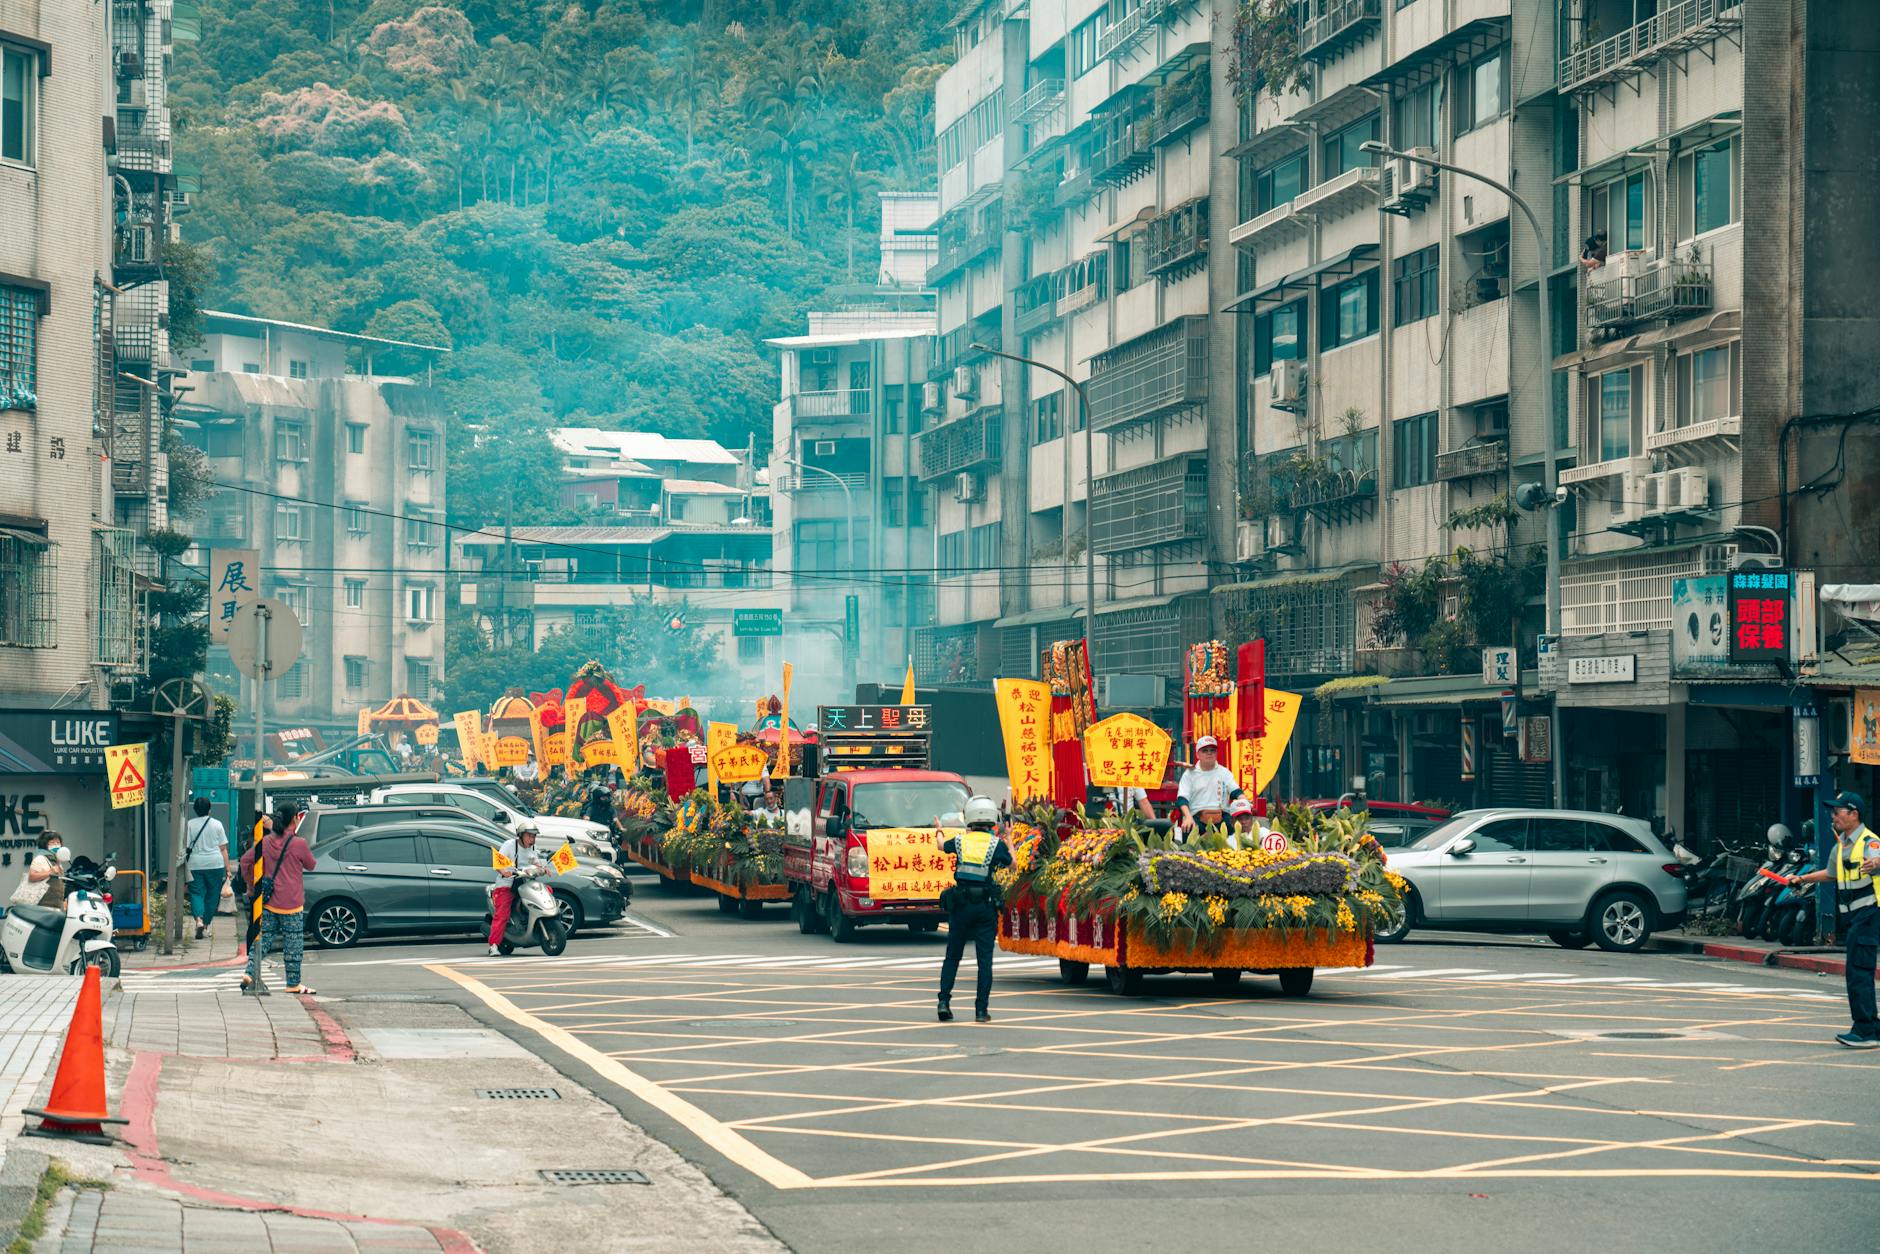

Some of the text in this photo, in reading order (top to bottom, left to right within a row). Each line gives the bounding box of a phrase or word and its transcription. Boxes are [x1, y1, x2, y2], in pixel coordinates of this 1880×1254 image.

[1737, 598, 1784, 624] 頭部
[1737, 624, 1784, 649] 保養
[1496, 652, 1510, 681] 理髮
[1011, 688, 1042, 701] 恭迎
[823, 708, 927, 729] 天上聖母
[51, 720, 110, 745] LUKE
[1267, 837, 1282, 851] 16
[873, 853, 957, 872] 松山慈祐宮
